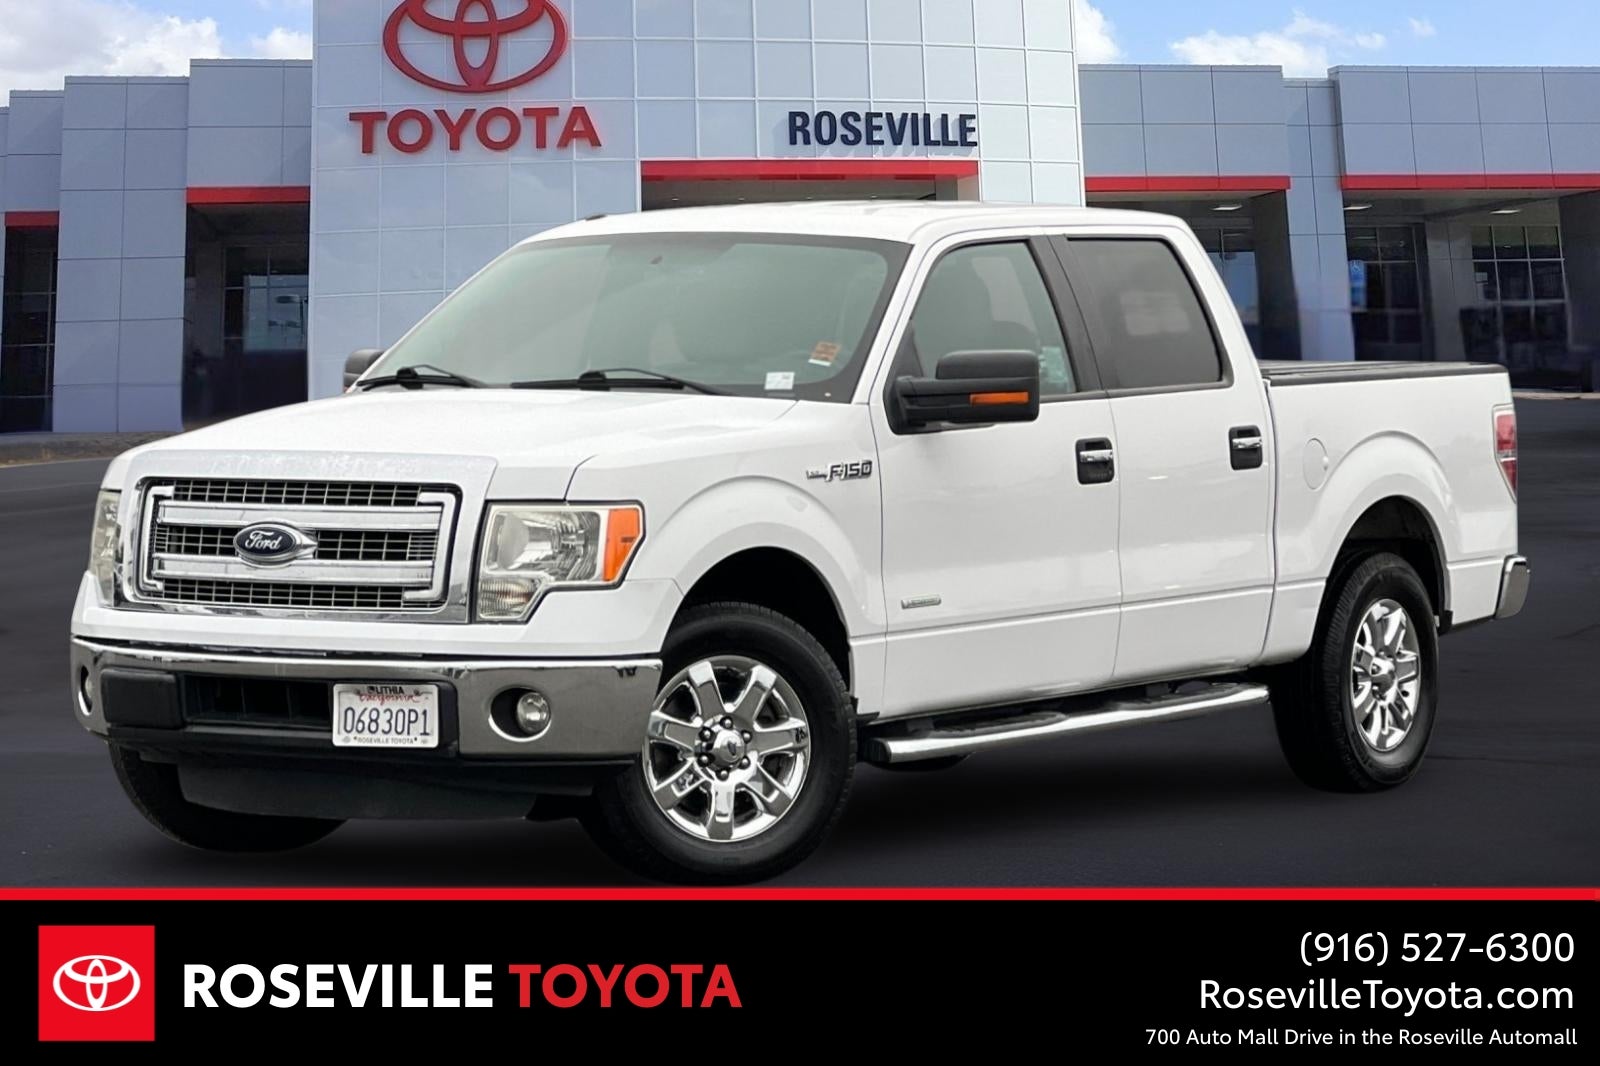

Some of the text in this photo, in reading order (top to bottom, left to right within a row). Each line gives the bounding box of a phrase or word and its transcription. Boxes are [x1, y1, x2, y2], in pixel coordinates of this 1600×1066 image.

[349, 106, 602, 154] TOYOTA
[788, 111, 978, 147] ROSEVILLE
[827, 460, 873, 482] F-150
[244, 529, 283, 550] Ford
[376, 686, 405, 694] LITHIA
[343, 706, 431, 736] 06830P1
[358, 736, 414, 745] ROSEVILLE TOYOTA
